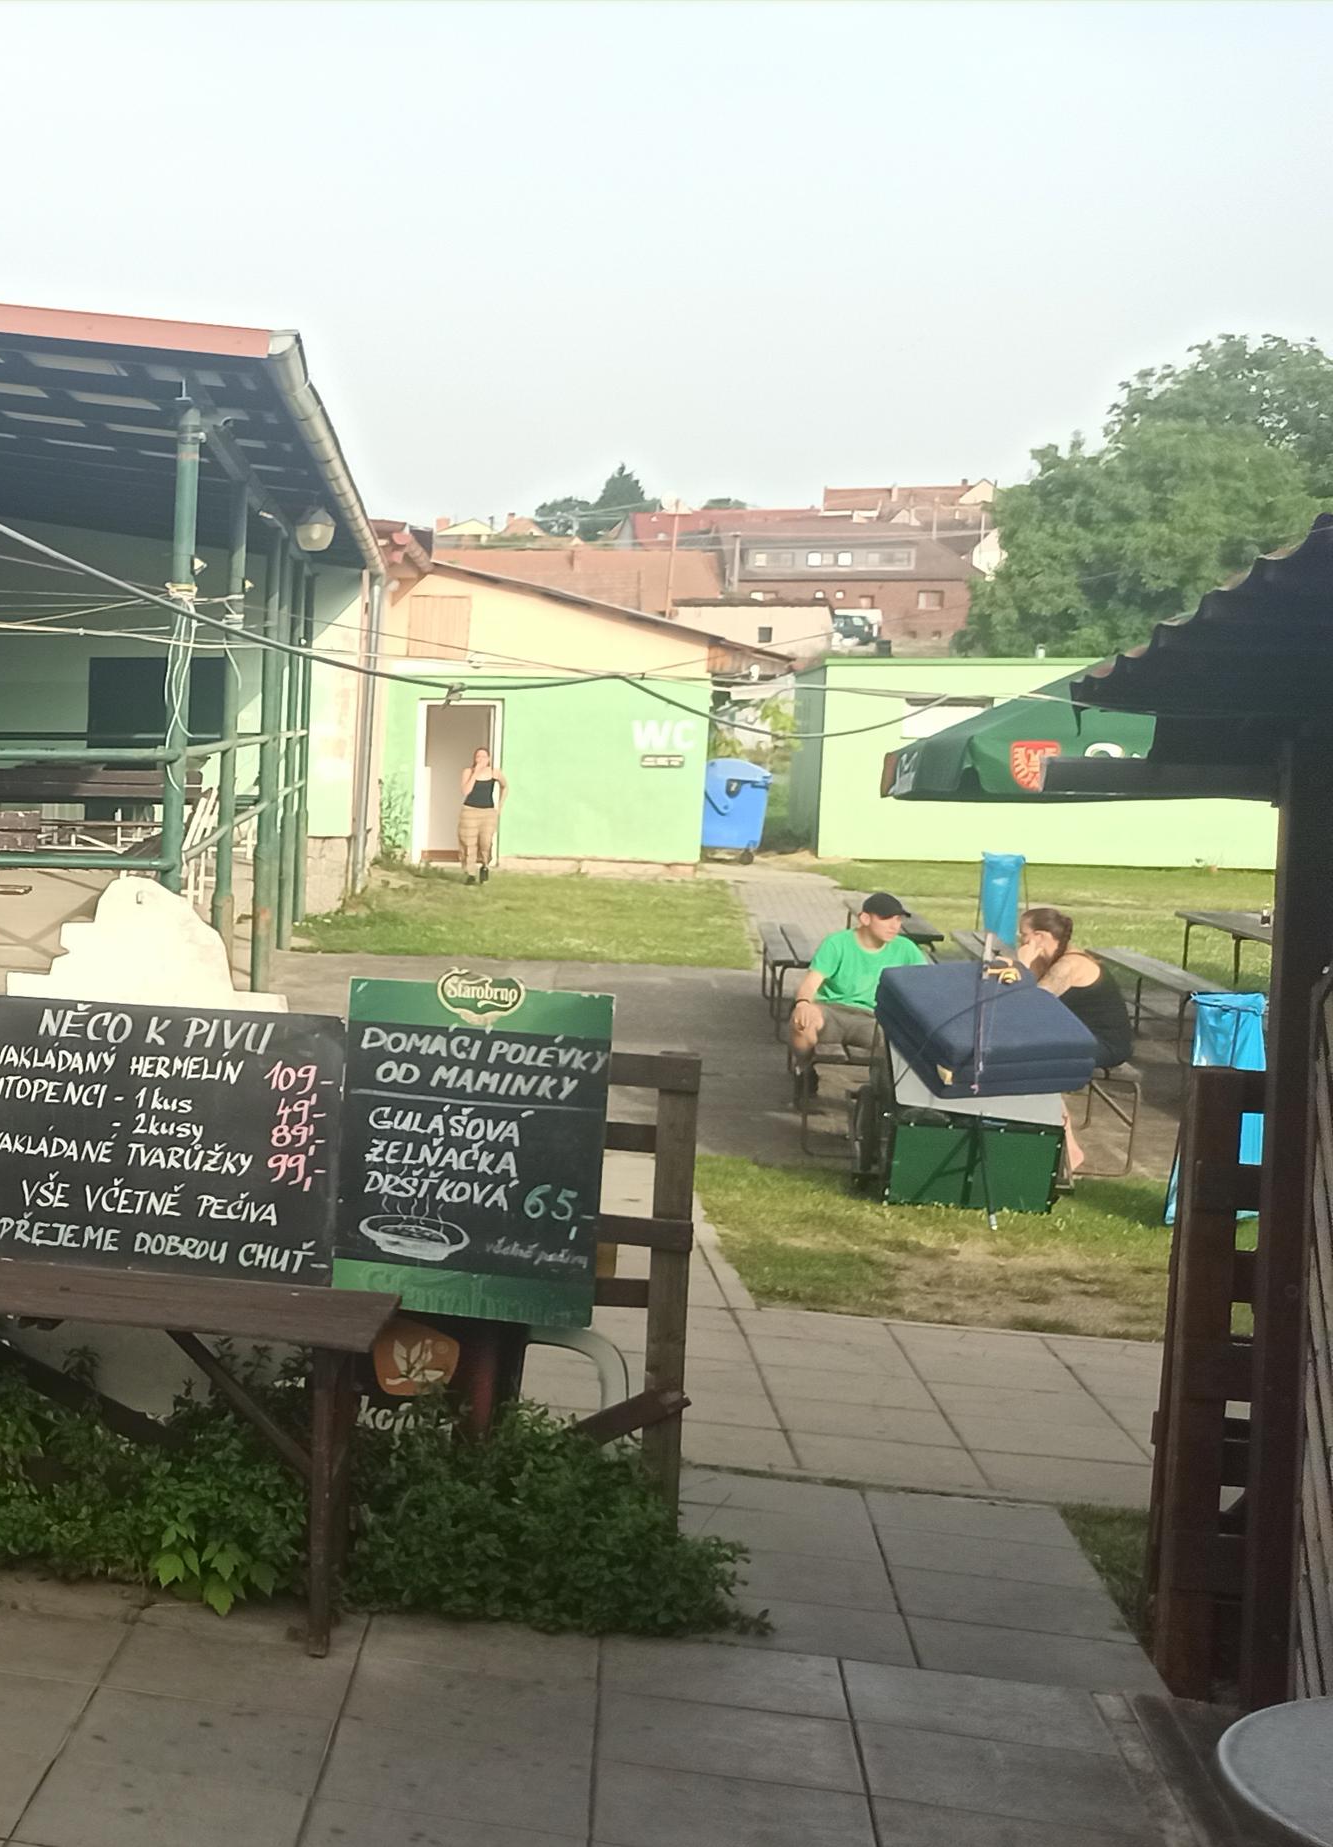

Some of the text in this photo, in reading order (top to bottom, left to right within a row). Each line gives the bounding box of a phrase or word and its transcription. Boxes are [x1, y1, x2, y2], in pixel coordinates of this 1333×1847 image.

[631, 720, 694, 750] WC
[445, 976, 522, 1008] Starobrno
[38, 1004, 275, 1055] NĚCO K PIVU
[360, 1023, 609, 1074] DOMÁCÍ POLÉVKY
[130, 1050, 245, 1085] HERMELÍN
[375, 1060, 579, 1100] OD MAMINKY
[135, 1091, 145, 1111] 1
[150, 1087, 194, 1114] kus
[368, 1104, 534, 1147] GULÁŠOVÁ
[128, 1144, 253, 1176] TVARŮŽKY
[364, 1138, 519, 1178] ZELŇAČKA
[21, 1171, 279, 1226] VŠE VČETNĚ PEČIVA
[363, 1169, 519, 1211] DRŠŤKOVÁ
[134, 1233, 227, 1264] DOBROU
